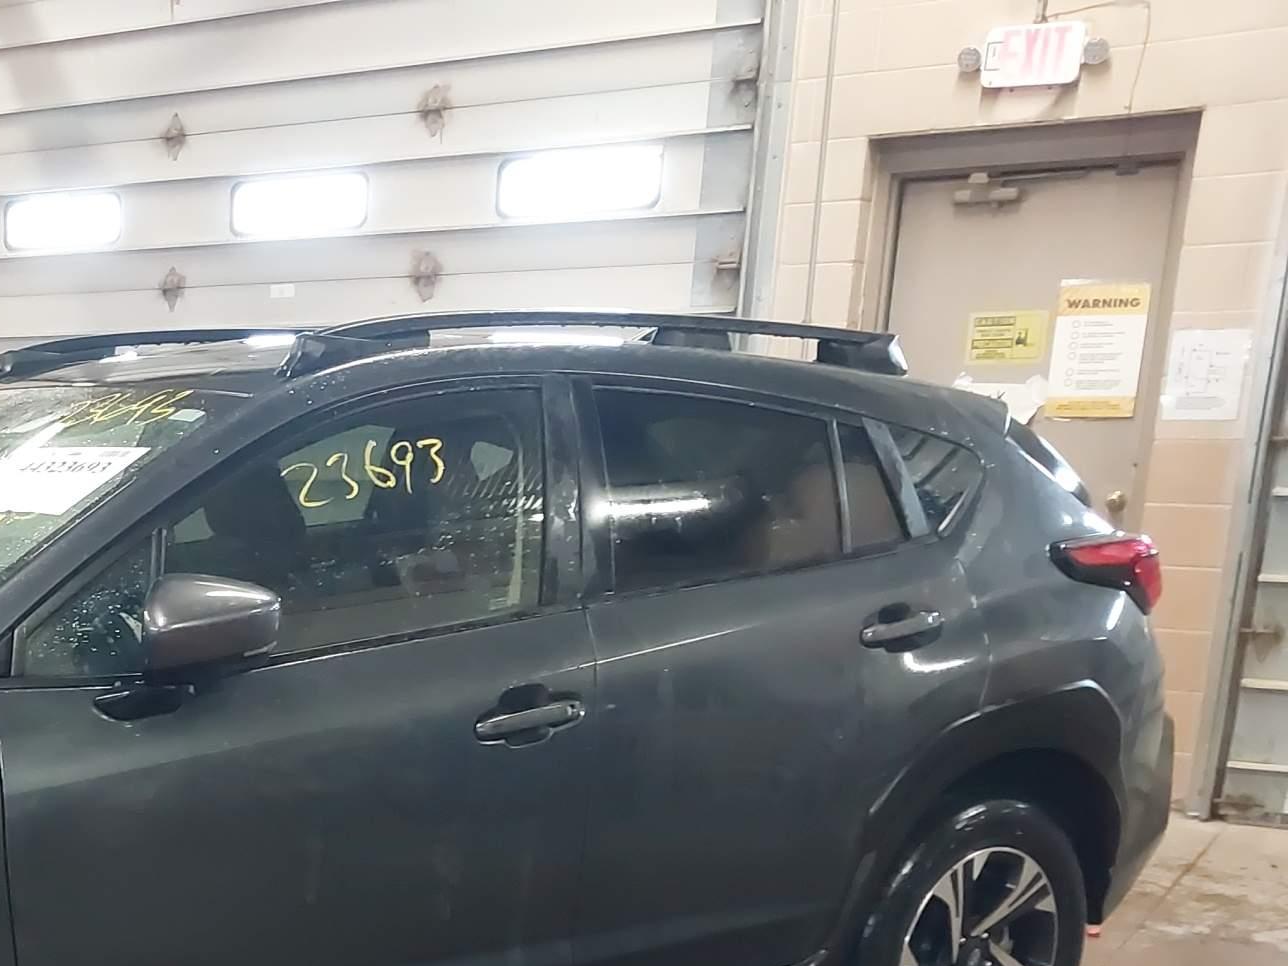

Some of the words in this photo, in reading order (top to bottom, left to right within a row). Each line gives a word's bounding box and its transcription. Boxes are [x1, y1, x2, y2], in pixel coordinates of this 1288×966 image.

[997, 25, 1073, 78] EXIT
[1065, 297, 1142, 309] WARNING
[280, 438, 445, 507] 23693
